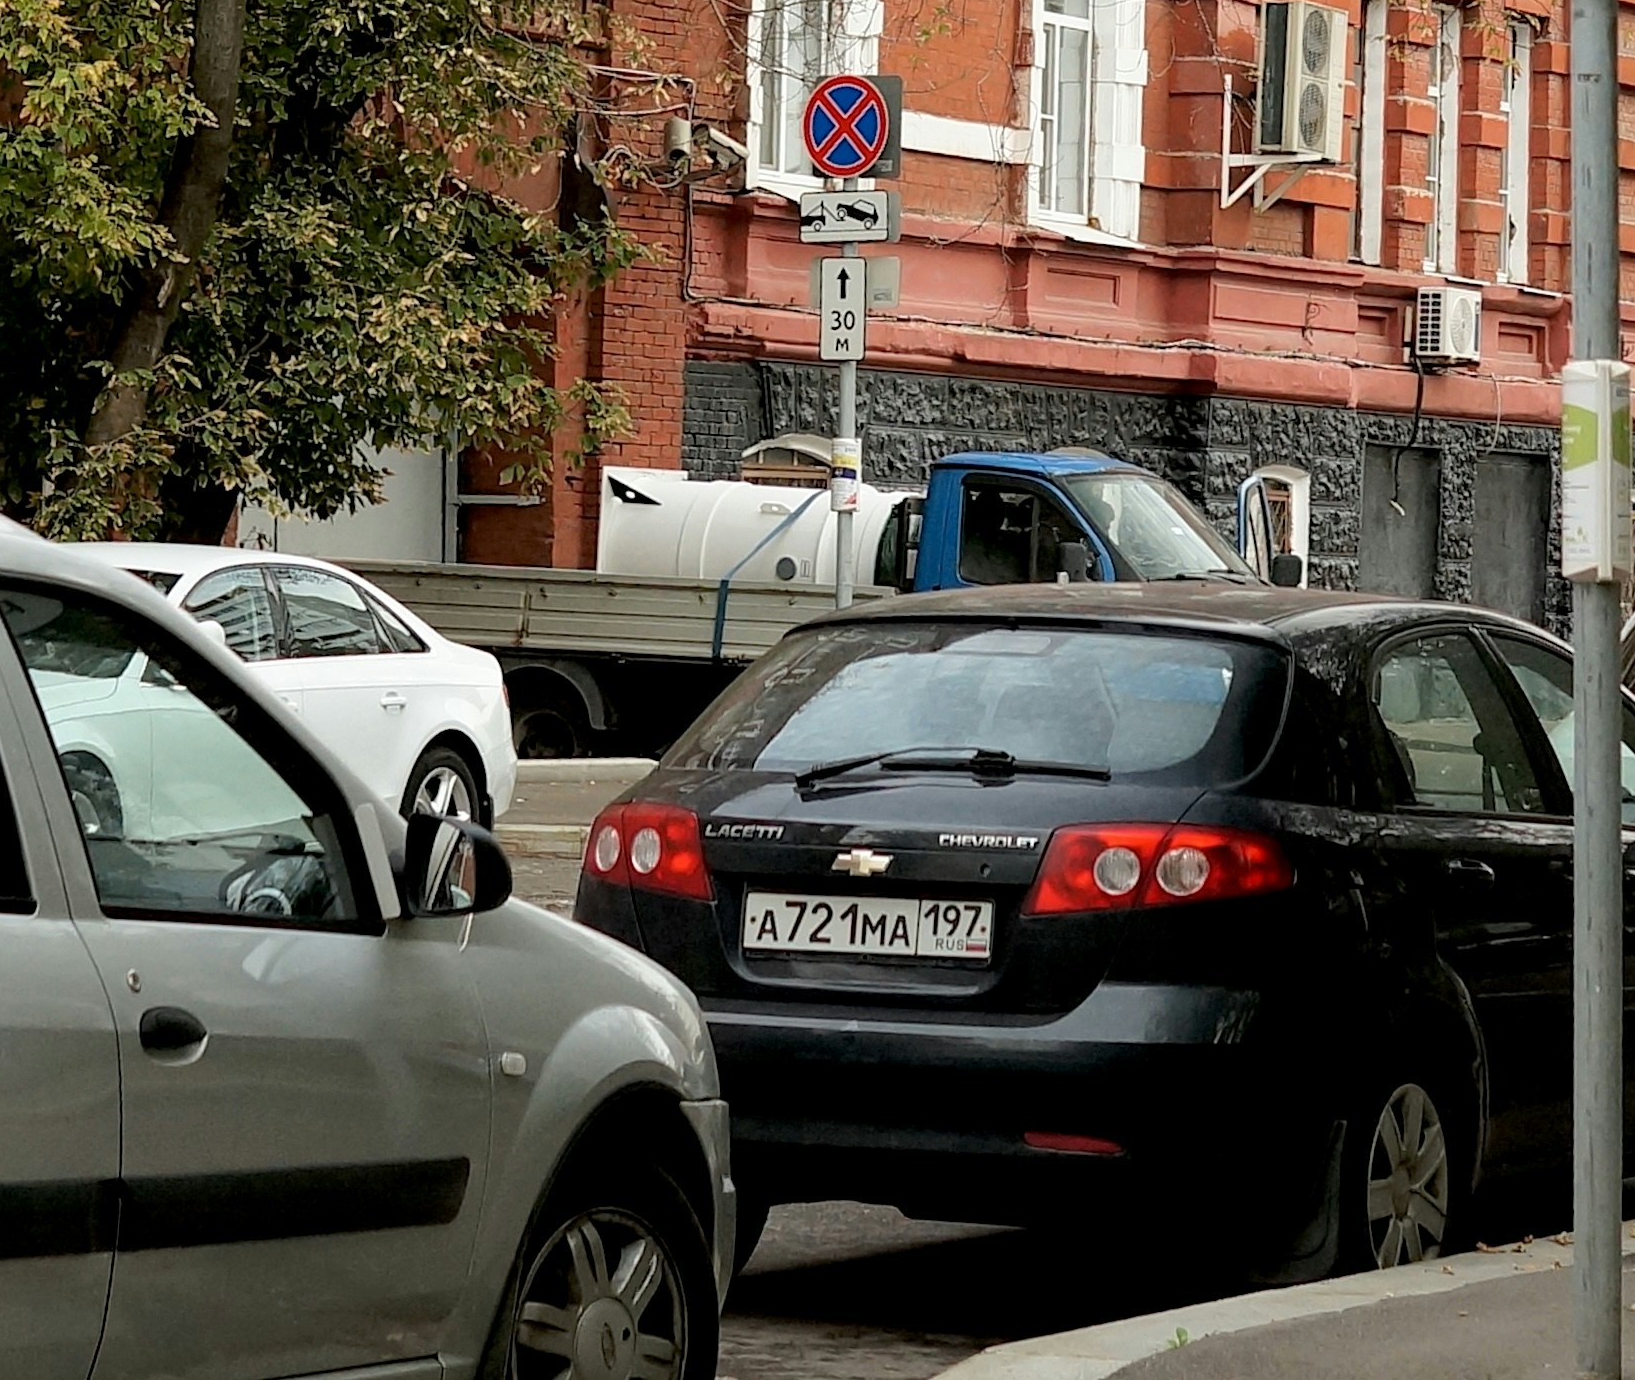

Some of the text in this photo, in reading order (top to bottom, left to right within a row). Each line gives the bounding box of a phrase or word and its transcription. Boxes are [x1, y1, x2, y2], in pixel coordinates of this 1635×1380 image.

[830, 310, 855, 331] 30
[704, 823, 785, 840] LACETTI
[938, 833, 1039, 850] CHEVROLET
[923, 903, 983, 938] 197
[935, 937, 964, 951] RUS
